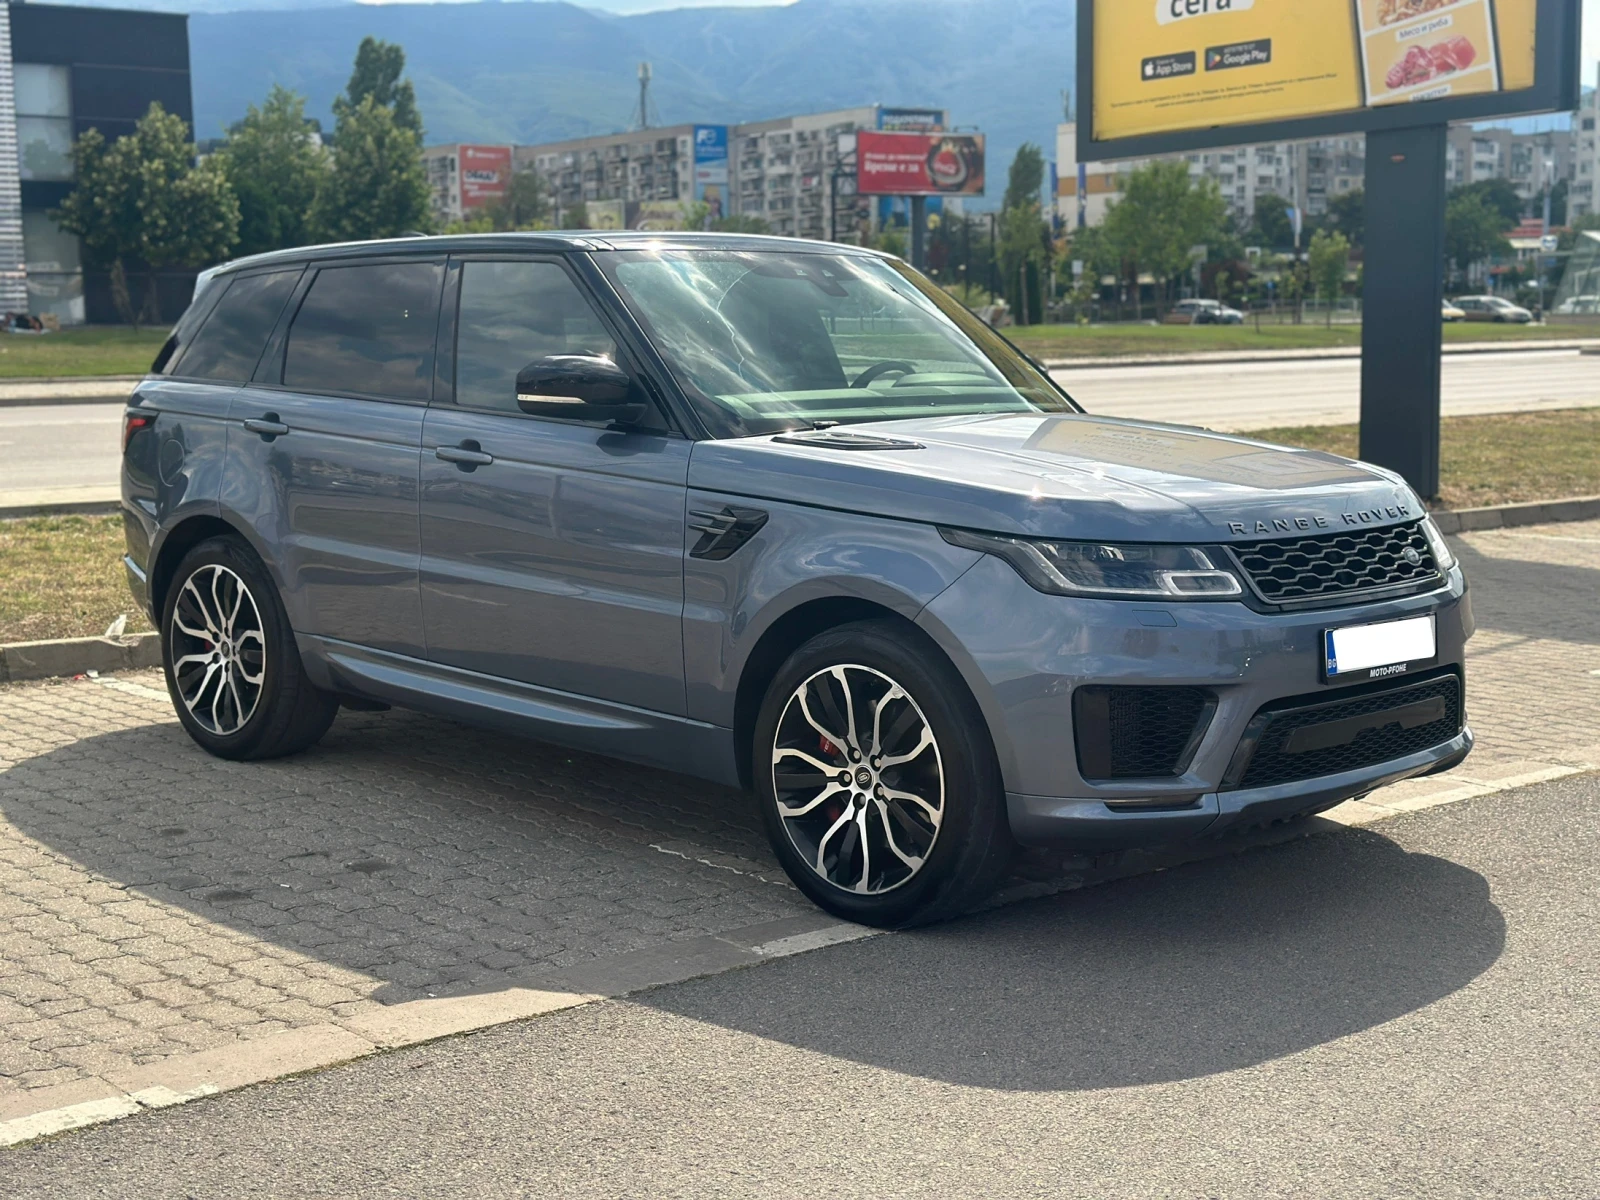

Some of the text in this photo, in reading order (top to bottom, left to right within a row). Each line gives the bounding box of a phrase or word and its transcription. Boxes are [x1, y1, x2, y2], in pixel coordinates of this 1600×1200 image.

[1399, 27, 1420, 38] Месо
[1428, 19, 1448, 31] риба
[1223, 53, 1251, 65] Google
[1251, 50, 1268, 61] Play
[1155, 64, 1172, 76] App
[1172, 61, 1193, 73] Store
[1228, 504, 1410, 535] RANGE ROVER
[1328, 658, 1337, 669] BG
[1369, 663, 1407, 678] MOTO-PFOHE
